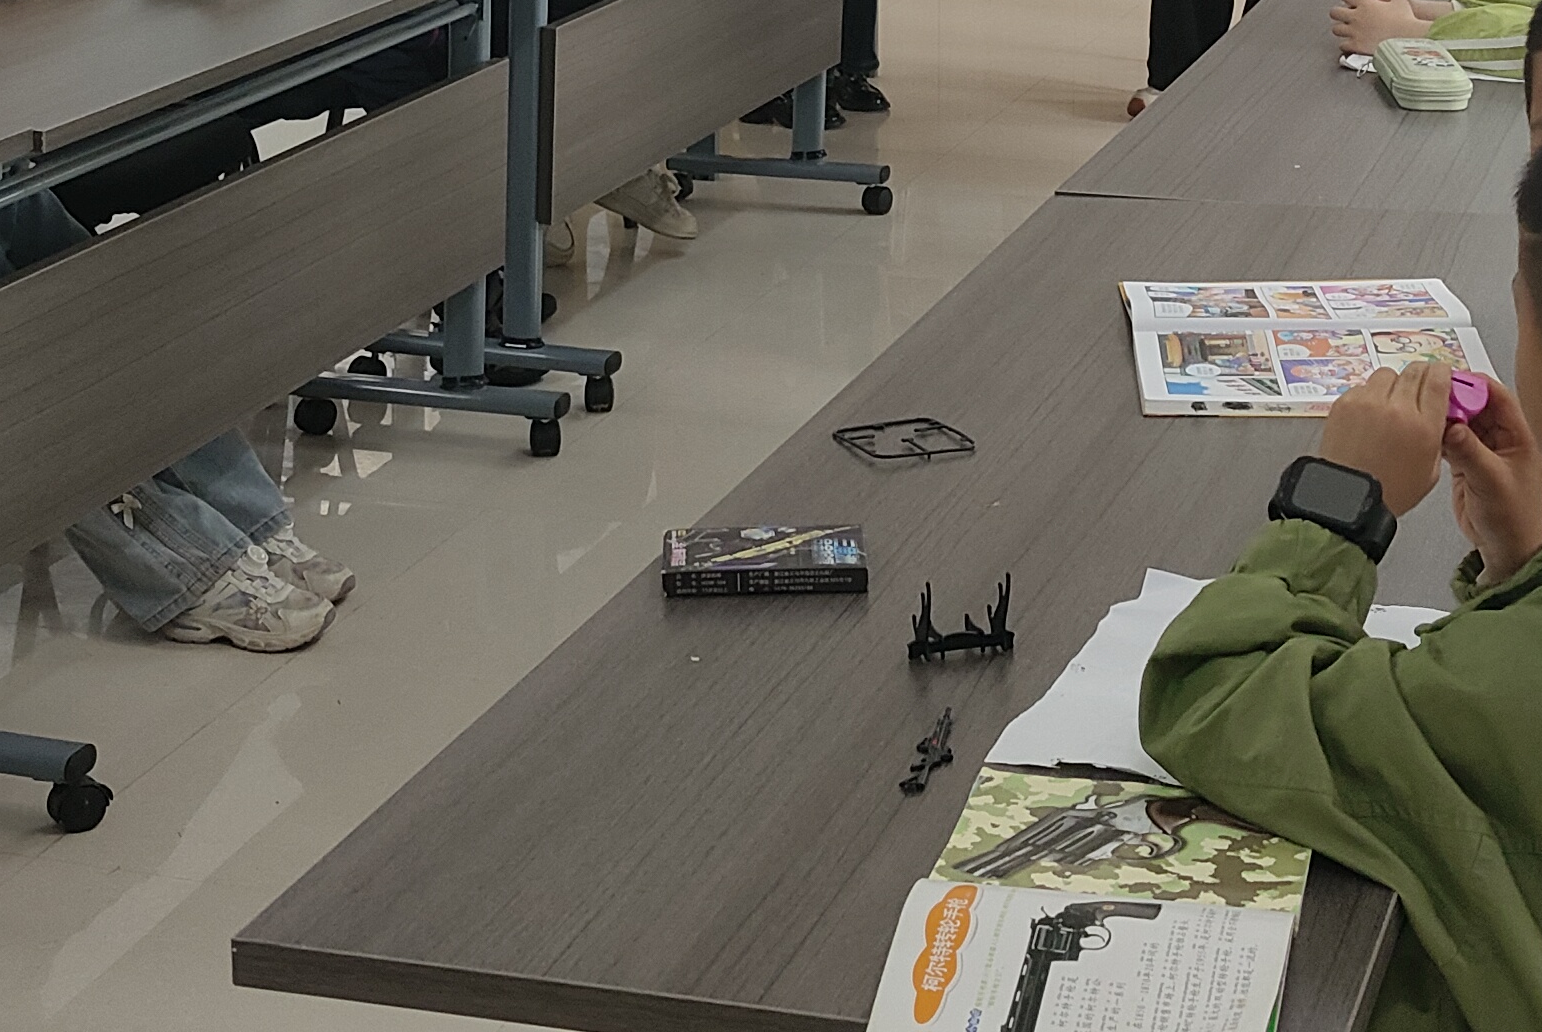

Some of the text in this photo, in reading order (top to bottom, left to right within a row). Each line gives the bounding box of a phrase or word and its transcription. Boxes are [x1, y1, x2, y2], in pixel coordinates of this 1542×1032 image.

[922, 897, 968, 993] 柯尔特转轮手枪
